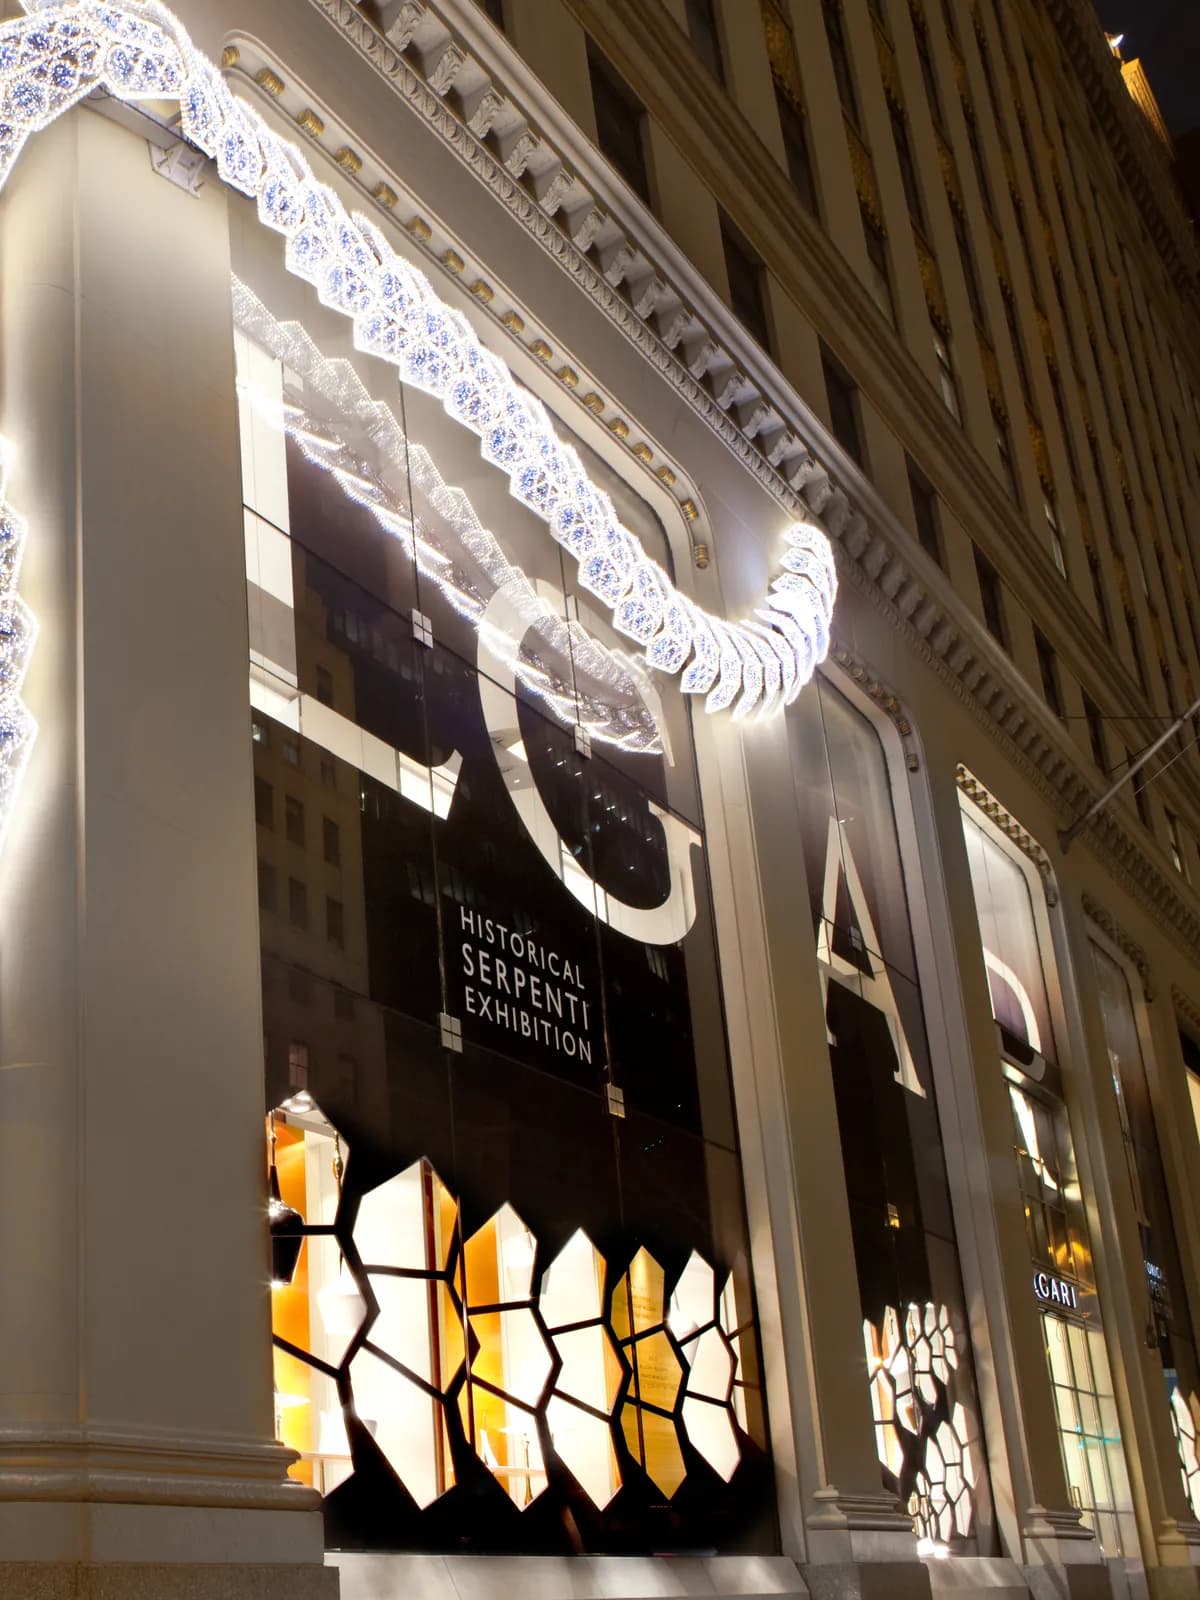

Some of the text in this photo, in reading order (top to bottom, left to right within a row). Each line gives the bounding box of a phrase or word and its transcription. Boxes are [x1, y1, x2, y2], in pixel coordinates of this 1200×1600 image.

[460, 905, 585, 990] HISTORICAL
[462, 943, 589, 1031] SERPENTI
[465, 985, 593, 1065] EXHIBITION
